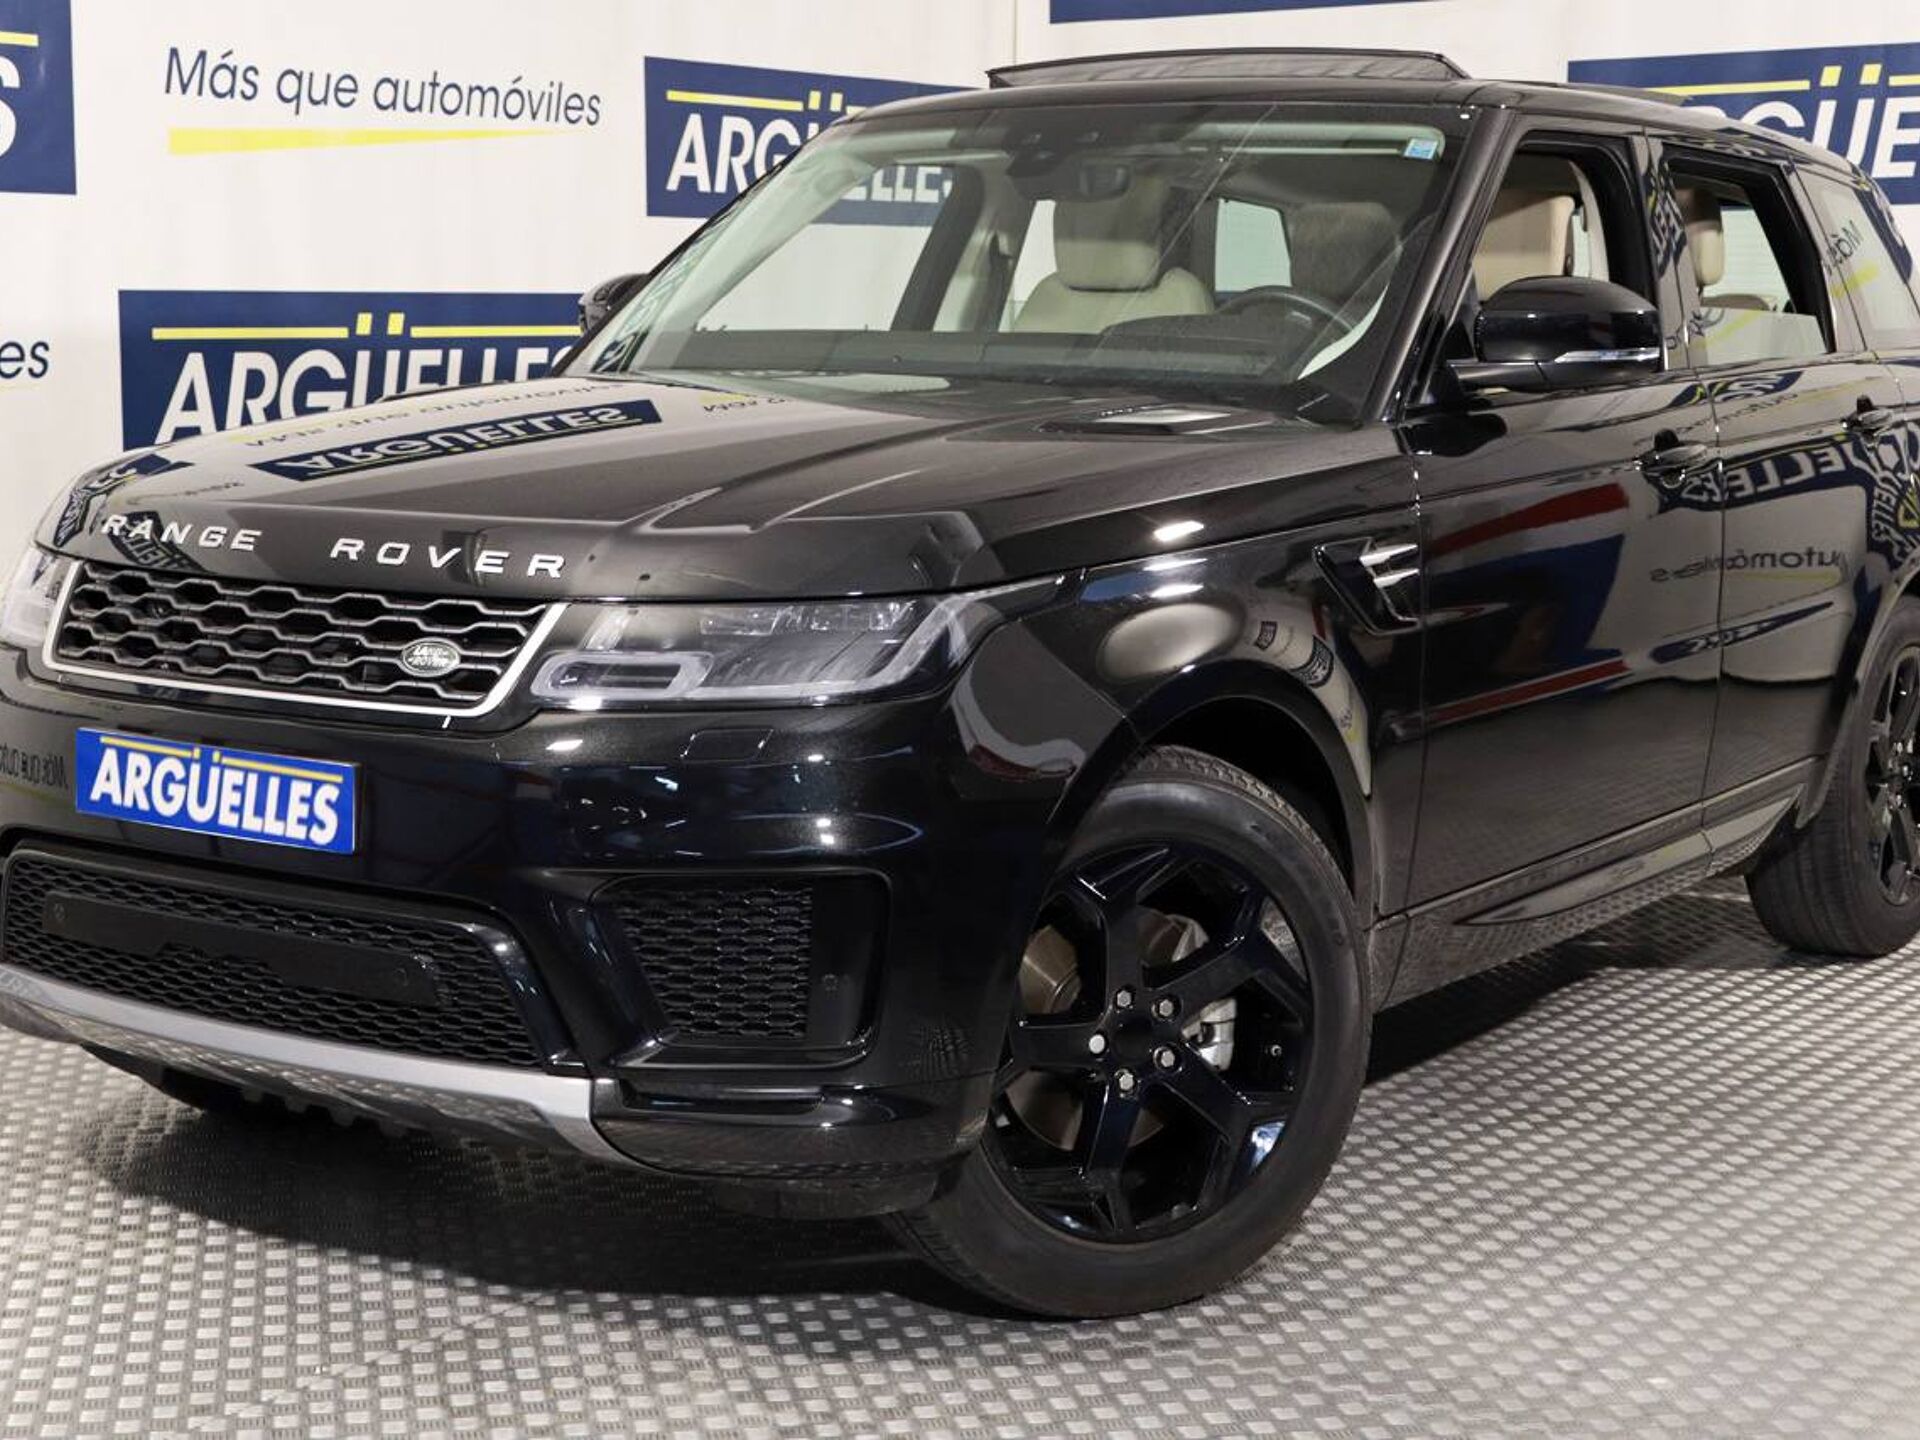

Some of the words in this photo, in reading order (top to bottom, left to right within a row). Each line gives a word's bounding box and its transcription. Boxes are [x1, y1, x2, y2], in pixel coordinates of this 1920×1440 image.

[165, 47, 259, 101] Más
[276, 68, 359, 116] que
[373, 70, 601, 126] automóviles
[101, 514, 262, 552] RANGE
[330, 537, 565, 579] ROVER
[90, 747, 340, 846] ARGÜELLES
